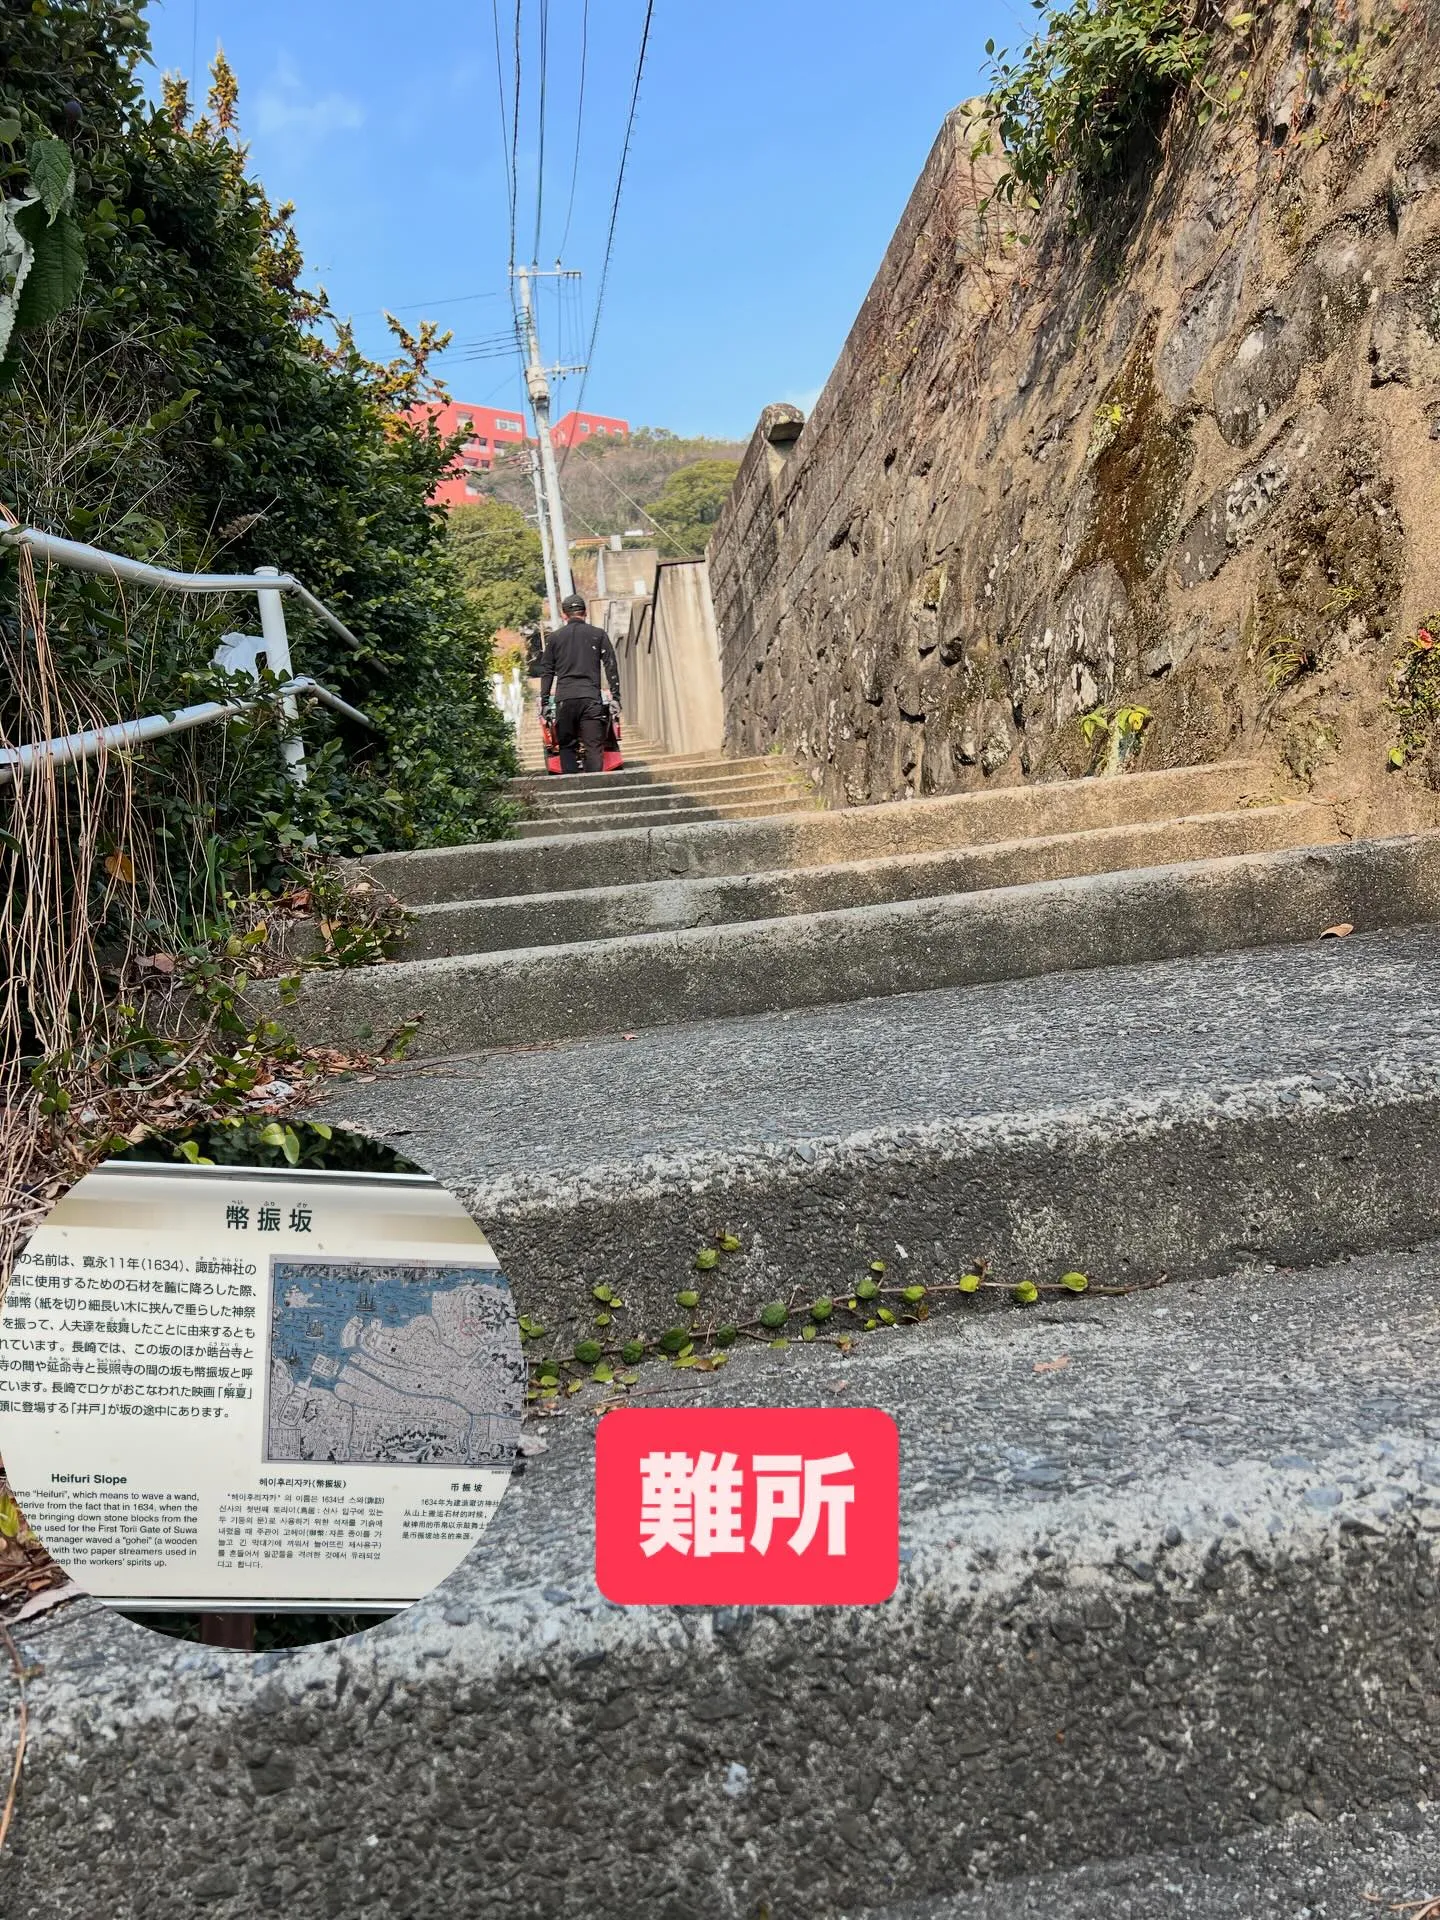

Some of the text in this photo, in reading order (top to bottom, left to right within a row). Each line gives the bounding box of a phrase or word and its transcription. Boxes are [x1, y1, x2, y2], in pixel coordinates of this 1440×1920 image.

[226, 1205, 313, 1233] 幣振坂
[17, 1253, 257, 1276] の名前は、寛永11年(1634)、諏訪神社の
[51, 1473, 127, 1486] Heifuri Slope
[13, 1490, 31, 1498] ame
[72, 1490, 97, 1499] which
[99, 1492, 129, 1500] means
[131, 1492, 140, 1500] to
[142, 1493, 164, 1501] wave
[174, 1493, 200, 1502] wand,
[322, 1495, 345, 1503] 1634년
[47, 1502, 68, 1510] from
[69, 1502, 83, 1510] the
[85, 1502, 101, 1510] fact
[103, 1503, 120, 1511] that
[122, 1503, 131, 1511] in
[134, 1503, 157, 1512] 1634,
[159, 1504, 182, 1512] when
[184, 1504, 198, 1512] the
[219, 1505, 242, 1513] 신사의
[40, 1513, 75, 1523] bringing
[104, 1514, 129, 1522] stone
[131, 1514, 159, 1523] blocks
[161, 1515, 182, 1523] from
[184, 1515, 198, 1523] the
[82, 1525, 96, 1533] the
[98, 1525, 117, 1533] First
[120, 1525, 138, 1533] Torii
[140, 1525, 161, 1534] Gate
[163, 1526, 172, 1534] of
[173, 1526, 198, 1534] Suwa
[86, 1536, 113, 1544] waved
[154, 1537, 163, 1545] (a
[165, 1537, 198, 1545] wooden
[91, 1548, 116, 1556] paper
[119, 1548, 163, 1556] streamers
[165, 1548, 187, 1556] used
[189, 1548, 197, 1556] in
[127, 1558, 152, 1568] spirits
[154, 1560, 167, 1568] up.
